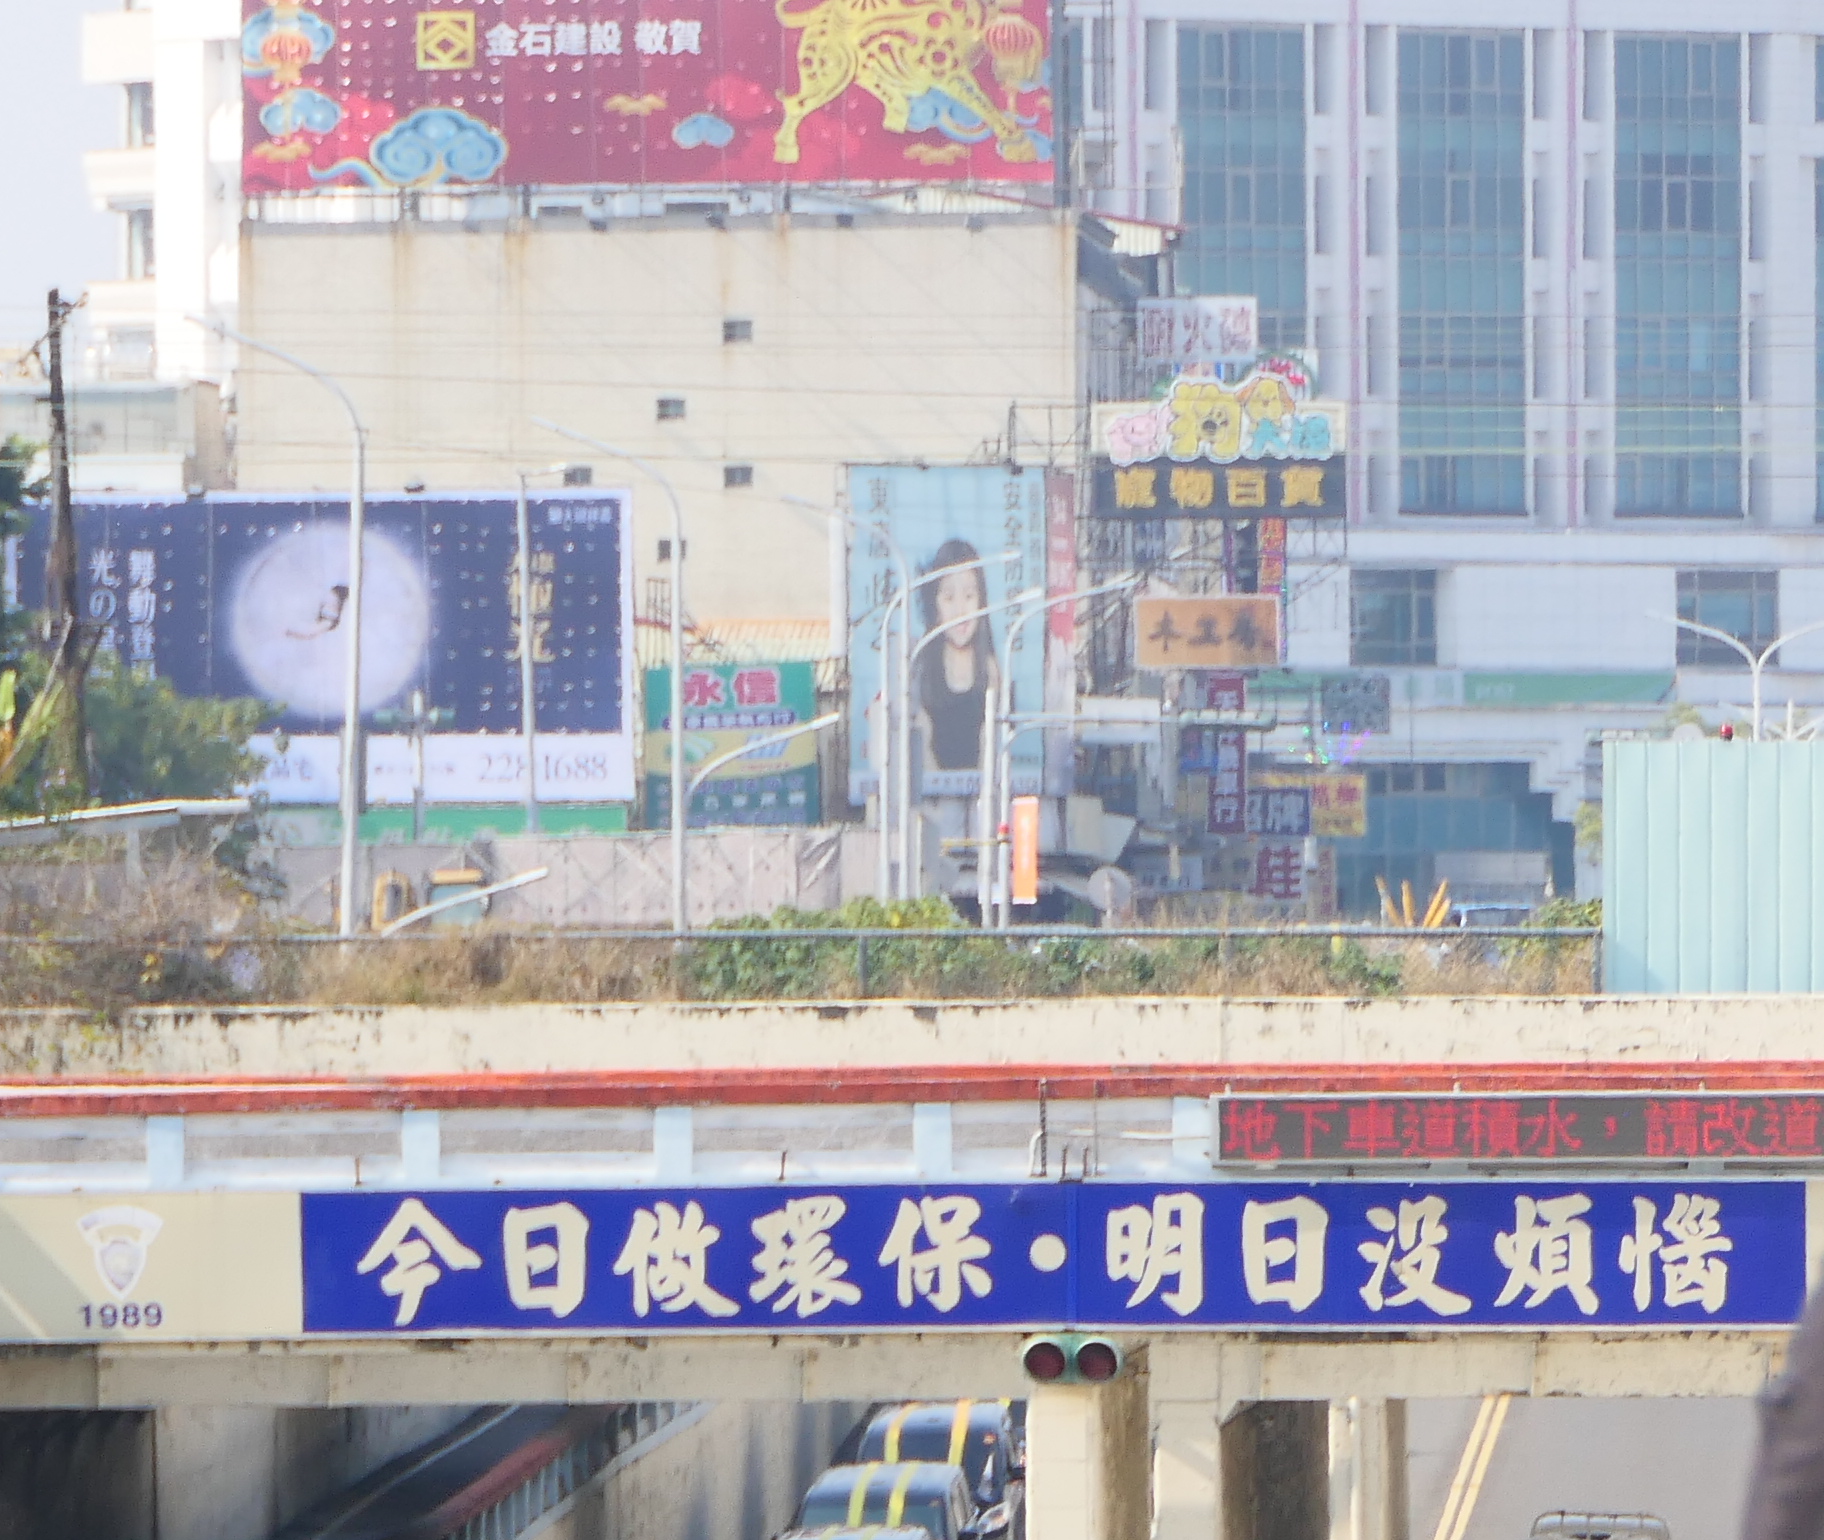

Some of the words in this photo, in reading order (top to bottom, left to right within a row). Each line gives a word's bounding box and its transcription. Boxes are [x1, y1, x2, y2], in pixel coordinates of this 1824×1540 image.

[485, 21, 623, 57] 金石建設
[634, 19, 702, 56] 敬賀
[79, 1303, 163, 1329] 1989
